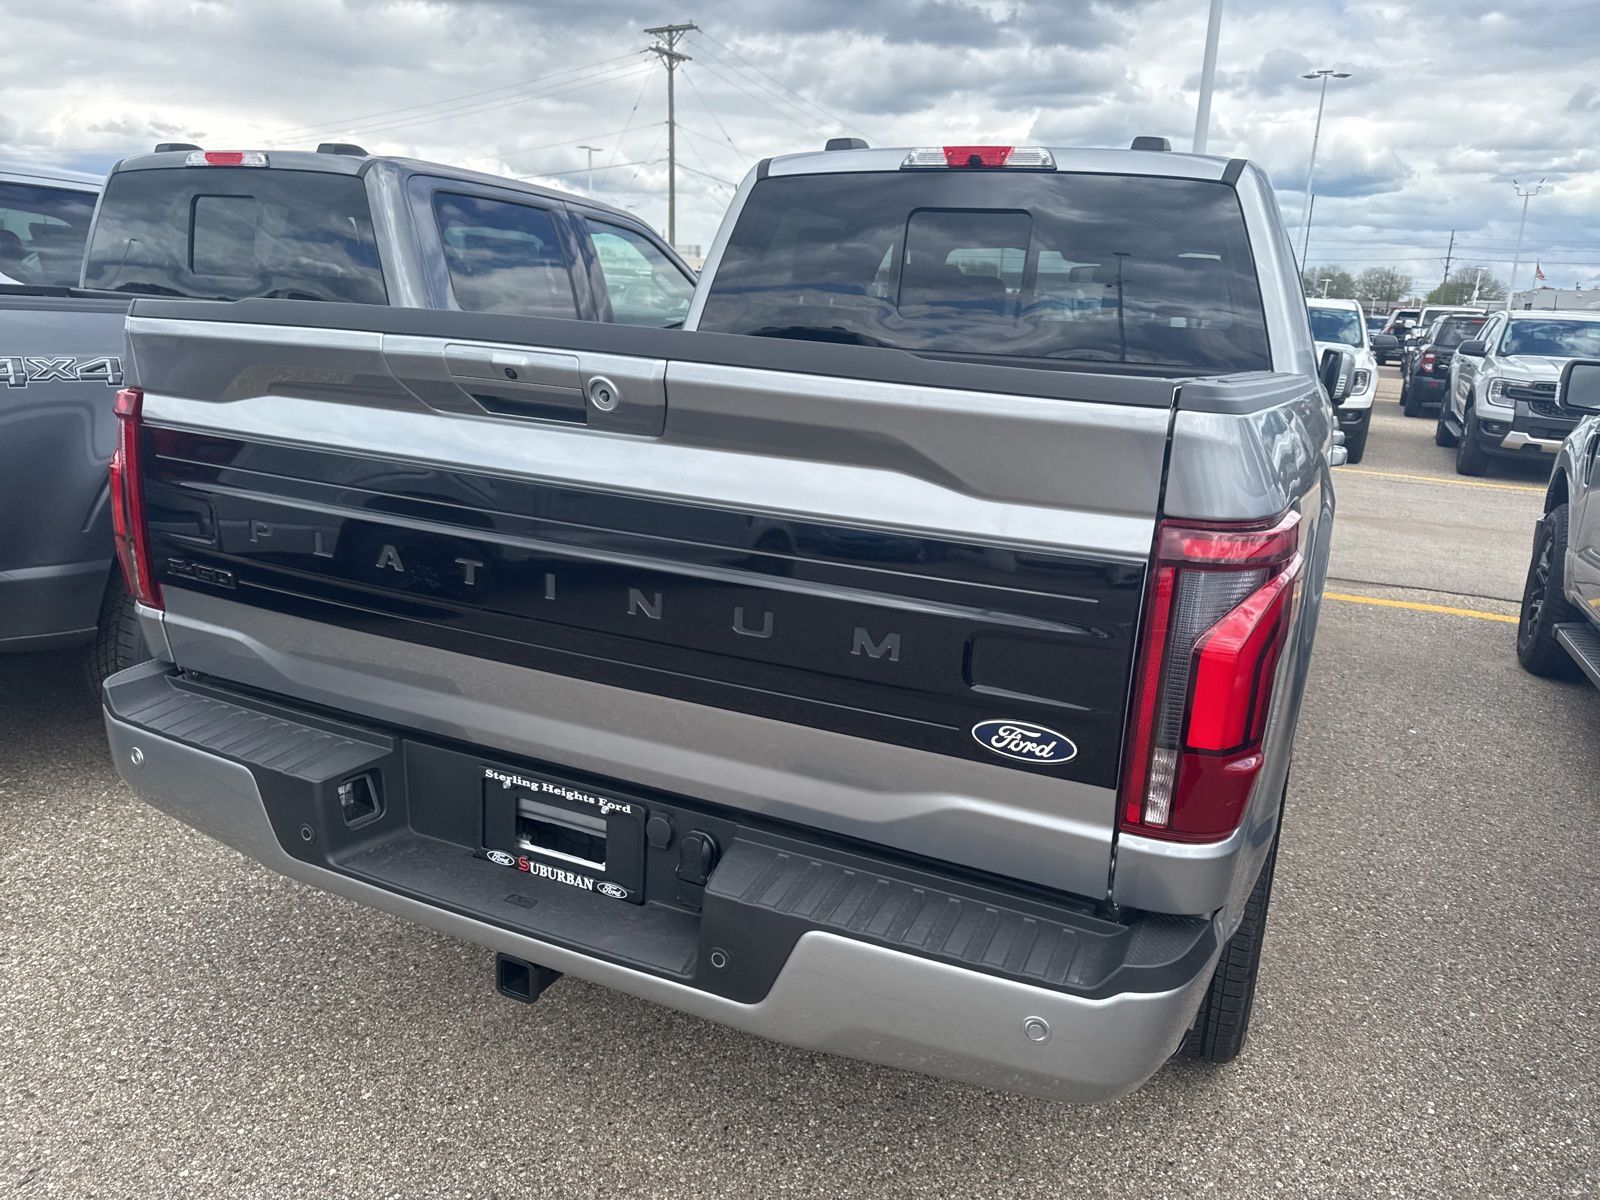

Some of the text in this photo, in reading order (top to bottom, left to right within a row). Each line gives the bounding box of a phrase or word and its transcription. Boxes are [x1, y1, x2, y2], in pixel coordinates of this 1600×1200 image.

[250, 518, 902, 663] PLATINUM
[990, 725, 1057, 758] Ford
[485, 769, 632, 814] Sterling Heights Ford
[518, 857, 593, 890] SUBURBAN
